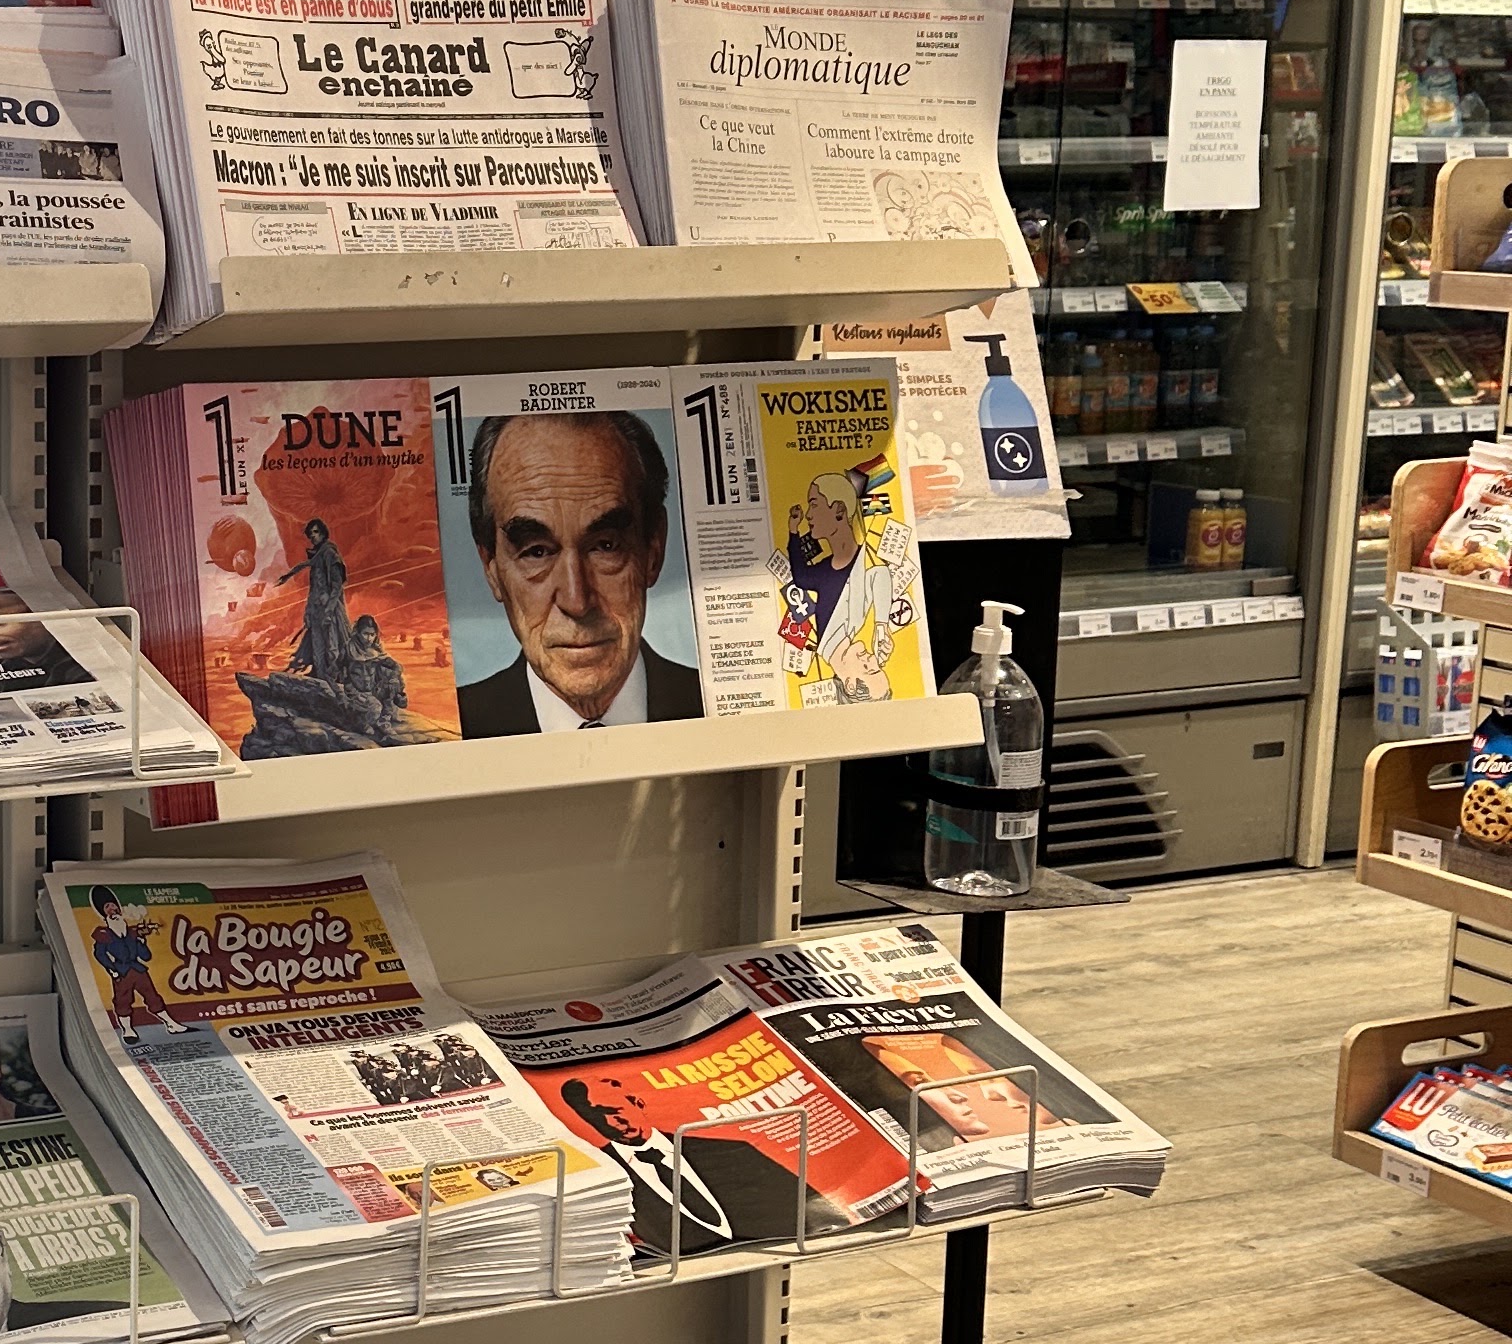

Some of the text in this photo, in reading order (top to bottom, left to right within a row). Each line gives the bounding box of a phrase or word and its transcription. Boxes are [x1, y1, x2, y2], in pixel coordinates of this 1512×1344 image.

[763, 25, 847, 52] MONDE
[293, 34, 490, 76] Le Canard
[710, 40, 911, 95] diplomatique
[318, 74, 473, 98] enchaîné
[9, 190, 29, 208] la
[33, 191, 125, 216] poussée
[887, 324, 942, 341] vigilants
[528, 382, 586, 398] ROBERT
[907, 375, 952, 384] SIMPLES
[910, 385, 967, 396] PROTÉGER
[520, 396, 596, 411] BADINTER
[761, 388, 887, 415] WOKISME
[281, 411, 403, 451] DUNE
[797, 417, 889, 434] FANTASMES
[172, 908, 348, 958] la Bougie
[173, 951, 363, 993] du Sapeur
[737, 946, 846, 984] FRANC
[755, 972, 876, 1002] TIREUR
[250, 996, 292, 1014] sans
[801, 1000, 957, 1033] La Fièvre
[247, 1017, 424, 1051] INTELLIGENTS
[642, 1031, 777, 1090] LA RUSSIE
[708, 1053, 797, 1101] SELON
[1399, 1083, 1446, 1116] LU
[1438, 1104, 1470, 1123] Petit
[25, 1159, 99, 1201] PEUT
